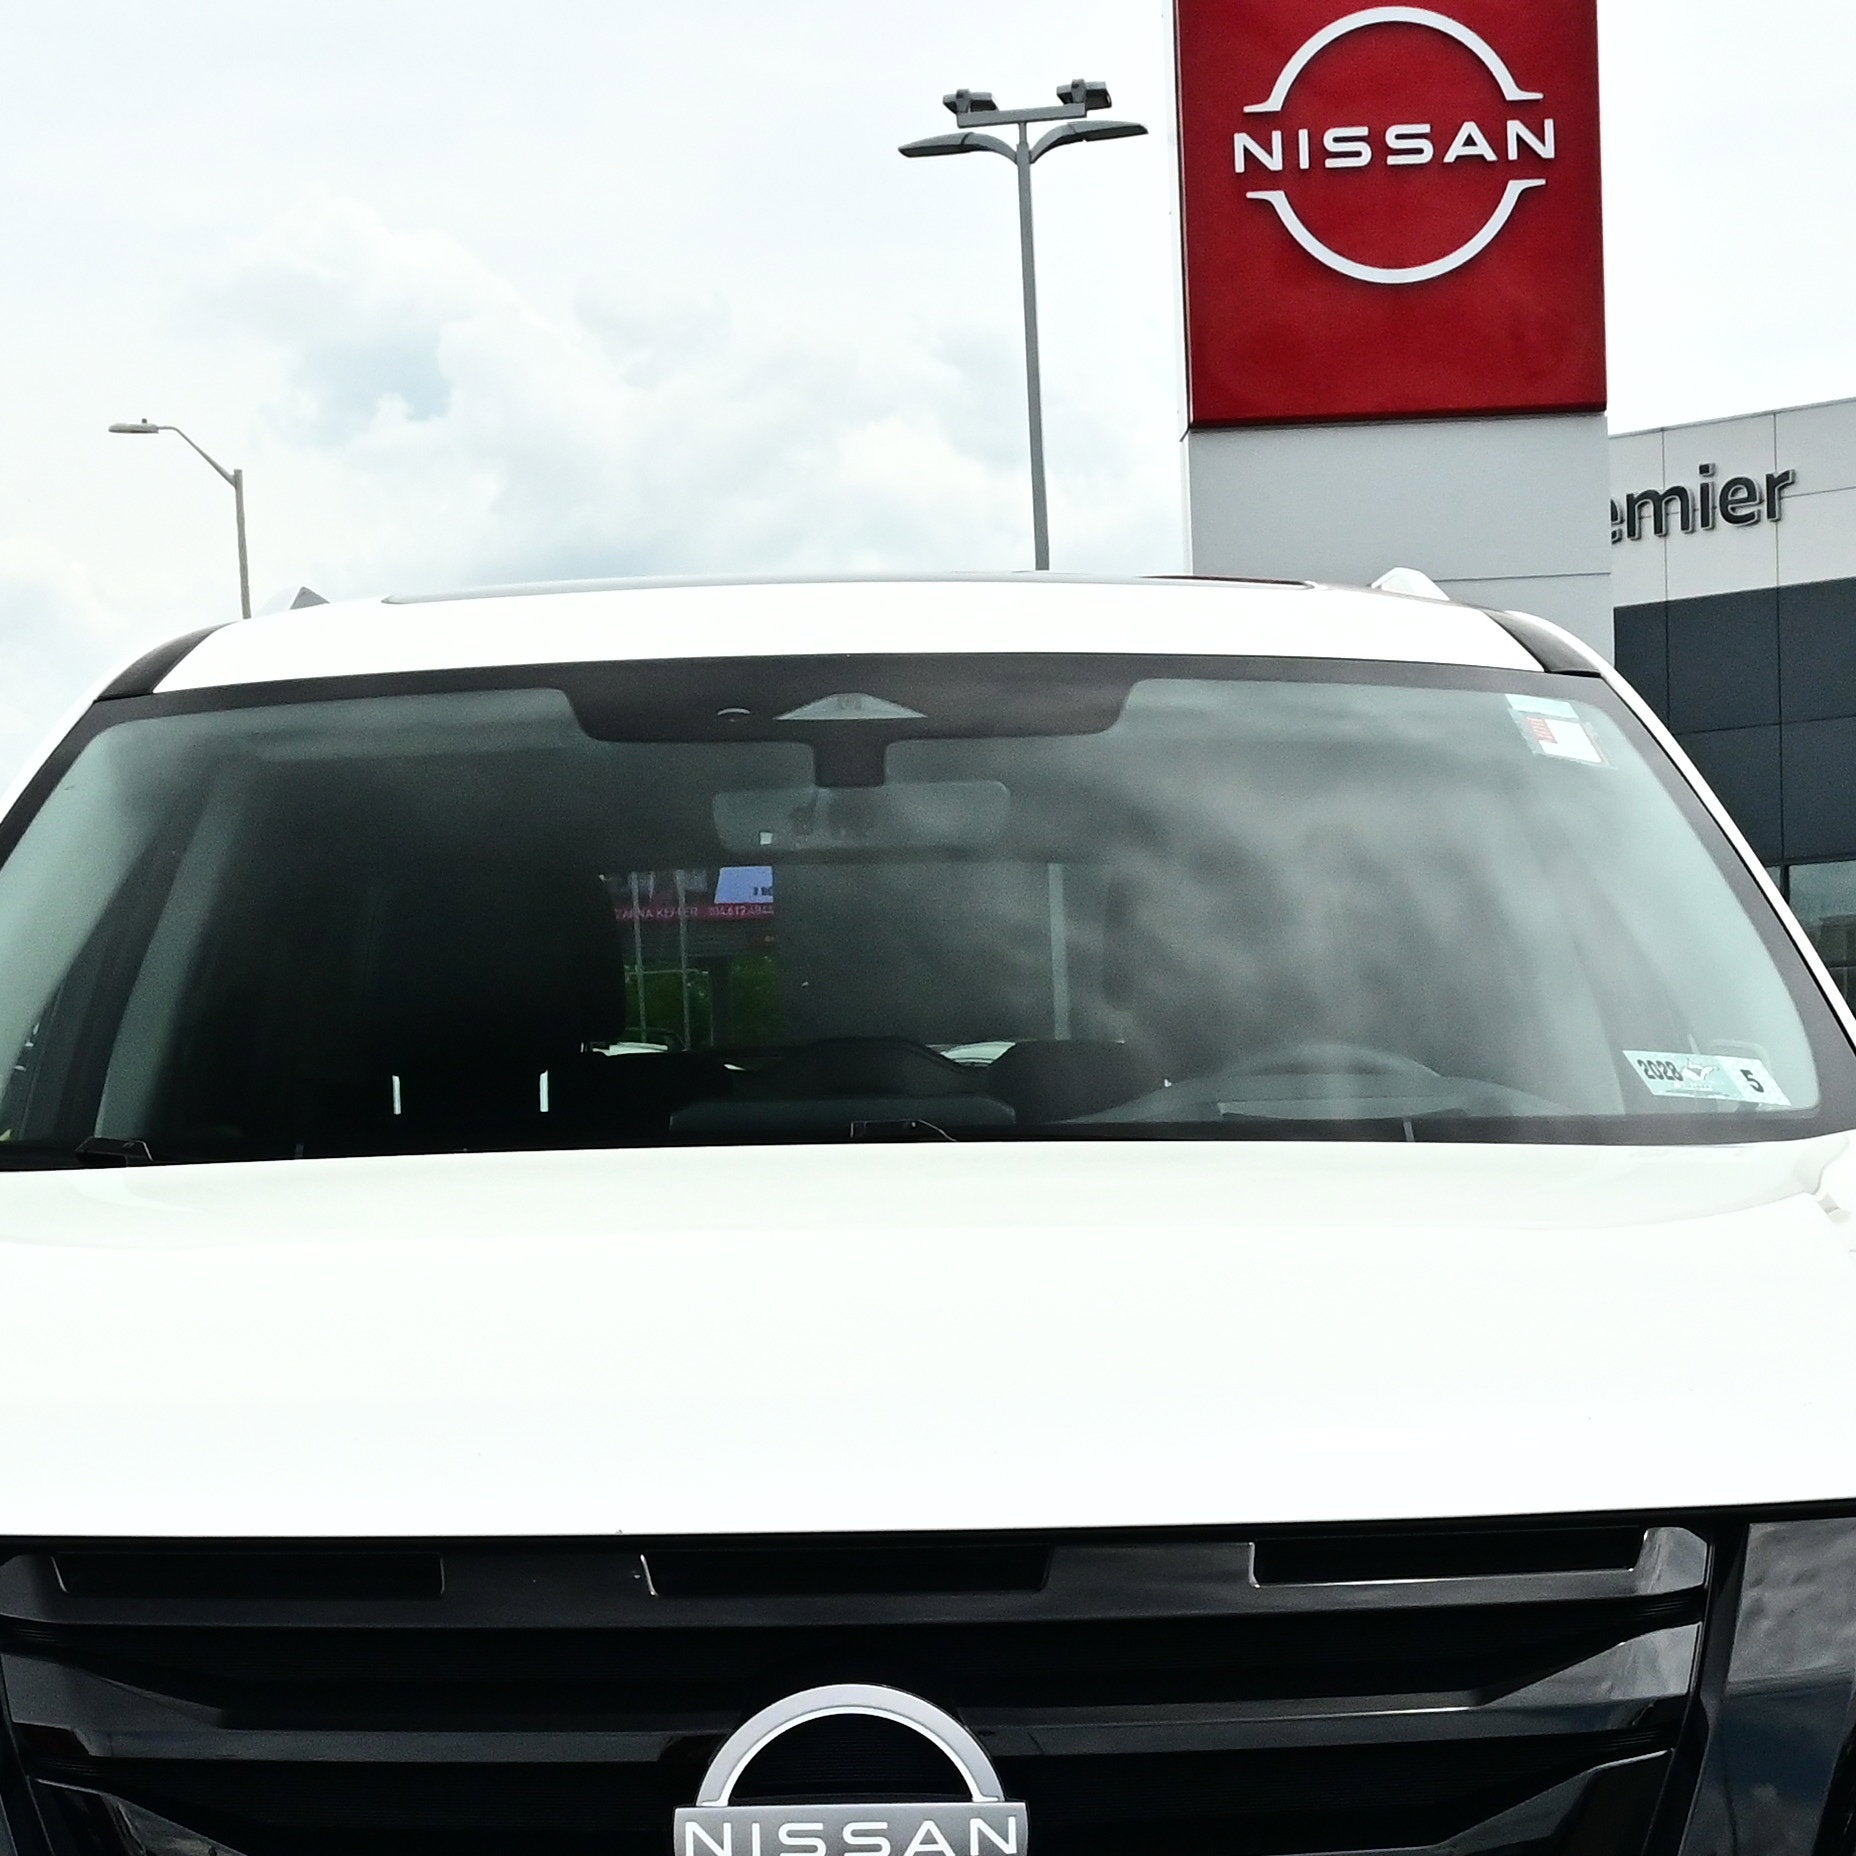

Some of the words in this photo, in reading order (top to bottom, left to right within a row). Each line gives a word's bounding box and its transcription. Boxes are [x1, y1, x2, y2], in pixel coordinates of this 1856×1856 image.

[1234, 118, 1555, 173] NISSAN
[1637, 1059, 1684, 1082] 2028
[1740, 1069, 1764, 1093] 5
